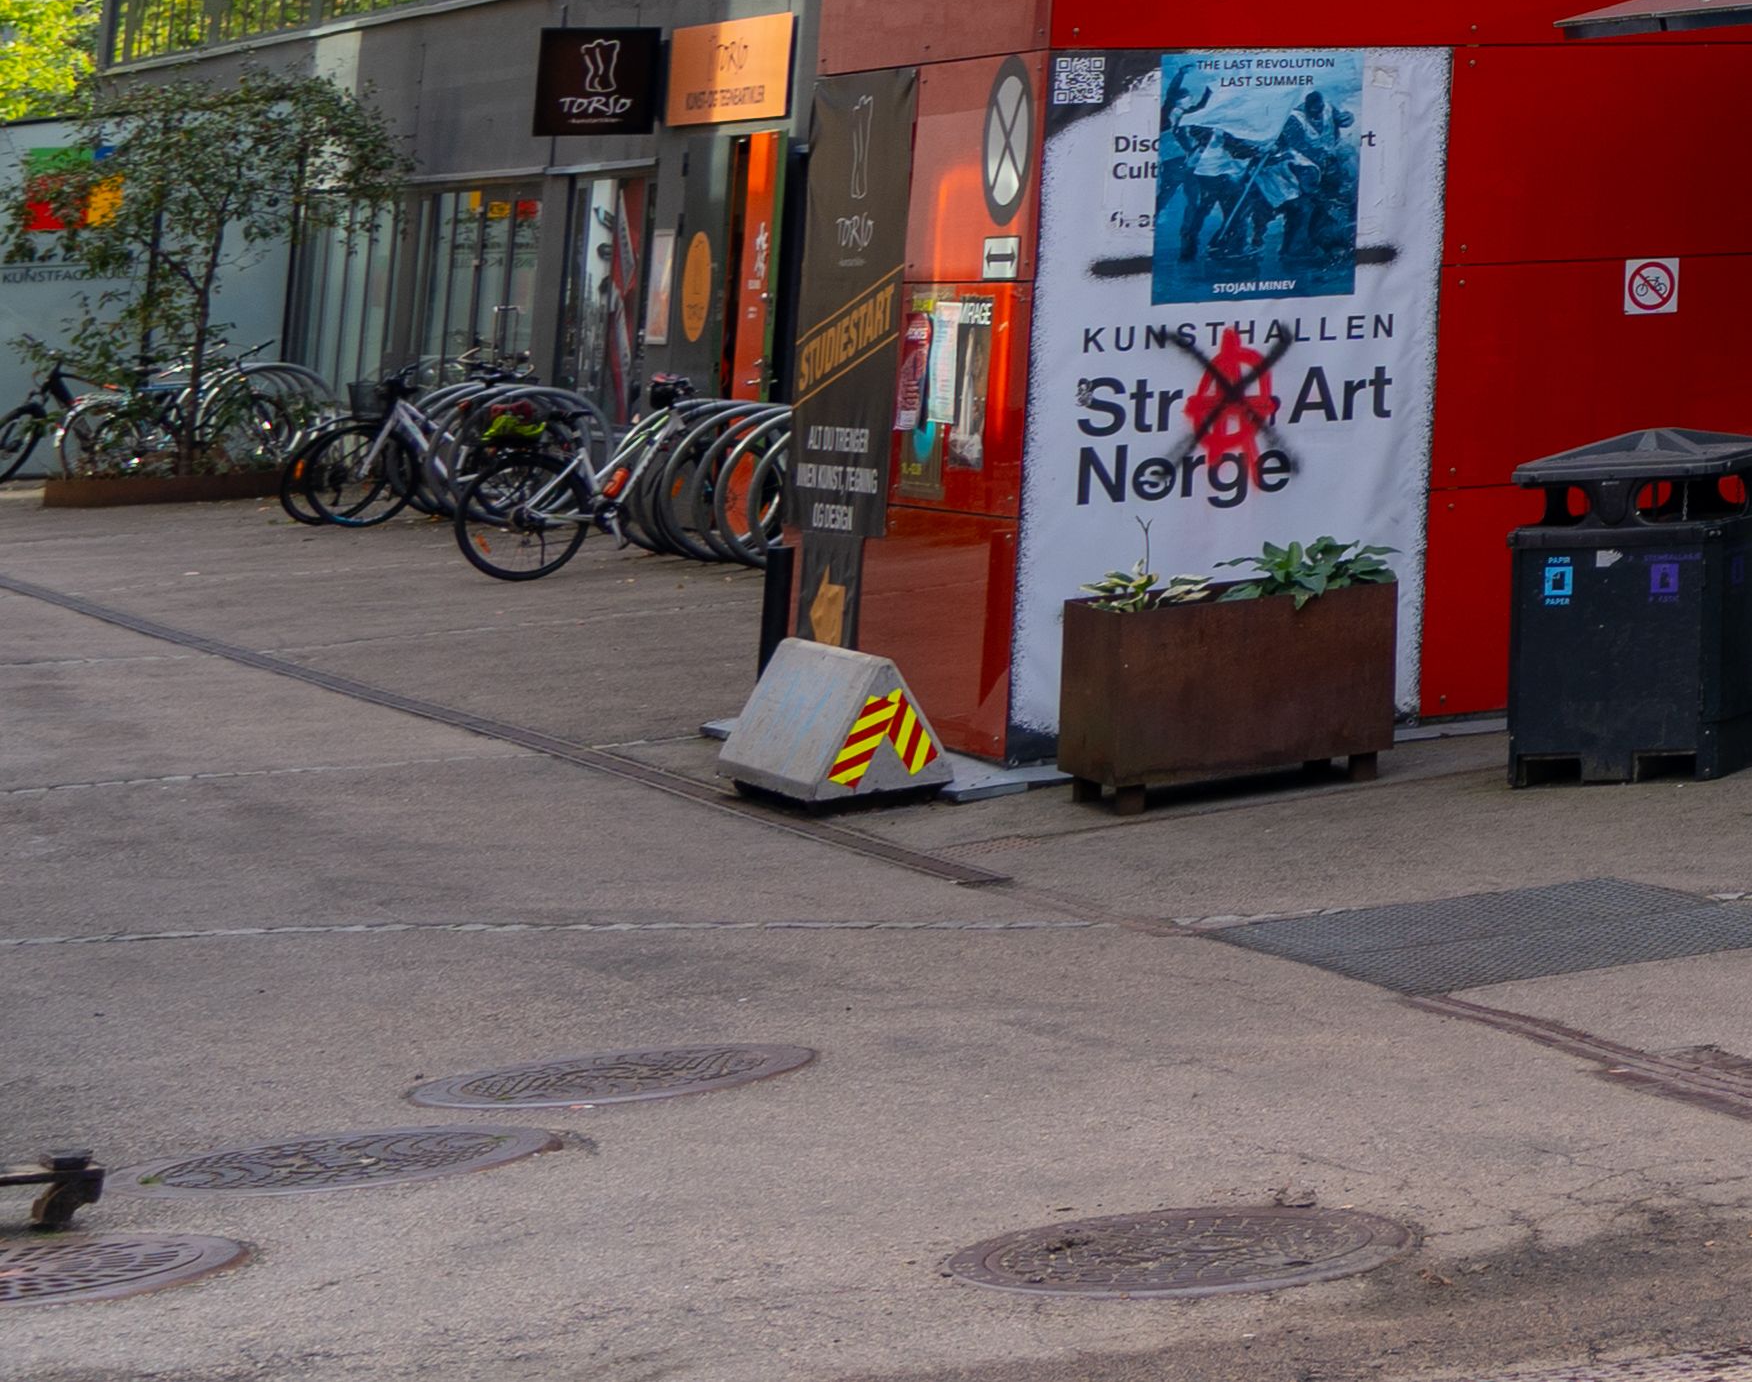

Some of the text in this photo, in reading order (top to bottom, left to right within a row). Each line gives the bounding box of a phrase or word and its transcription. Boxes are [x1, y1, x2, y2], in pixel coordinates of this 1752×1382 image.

[1197, 56, 1335, 71] THE LAST REVOLUTION
[1220, 74, 1314, 89] LAST SUMMER
[559, 94, 633, 115] TORSO
[1213, 279, 1296, 296] STOJAN MINEV
[800, 283, 895, 391] STUDIESTART
[1083, 314, 1395, 354] KUNSTHALLEN
[1289, 366, 1393, 425] Art
[1077, 444, 1291, 509] Norge
[812, 502, 825, 528] OG
